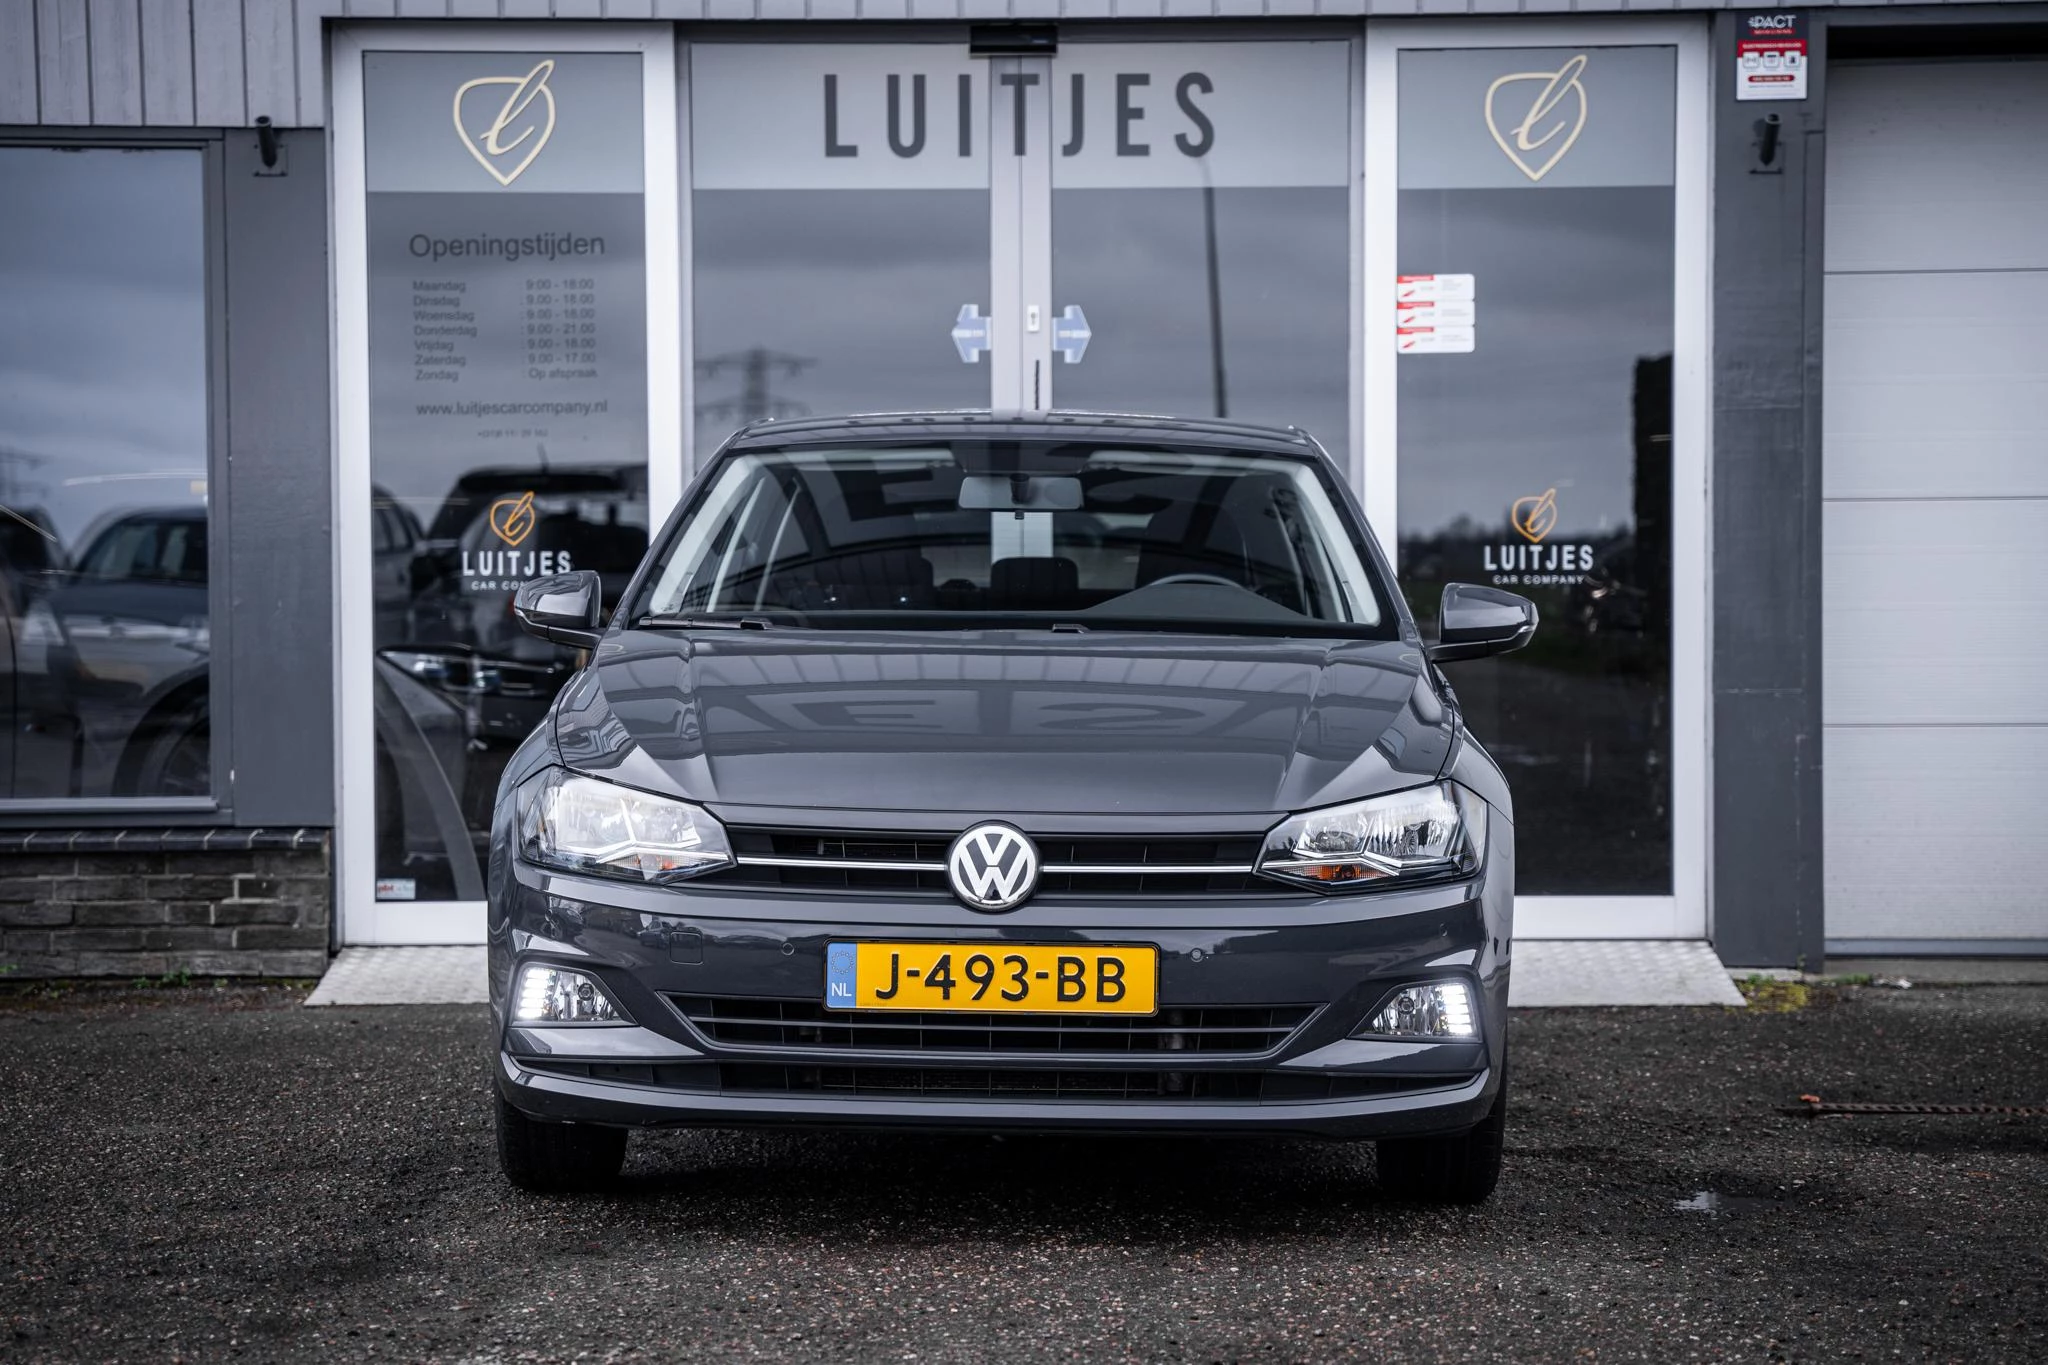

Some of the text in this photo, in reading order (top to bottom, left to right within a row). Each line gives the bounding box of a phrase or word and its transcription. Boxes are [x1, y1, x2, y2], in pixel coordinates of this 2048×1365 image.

[824, 72, 1215, 158] LUITJES
[409, 232, 605, 262] Openingstijden
[413, 280, 466, 293] Maandag
[416, 400, 608, 418] www.luitjescarcompany.nl
[462, 550, 571, 576] LUITJES
[1484, 544, 1594, 571] LUITJES
[471, 580, 496, 591] CAR
[1493, 574, 1585, 585] CAR COMPANY
[875, 953, 1126, 1003] J-493-BB
[831, 982, 852, 998] NL
